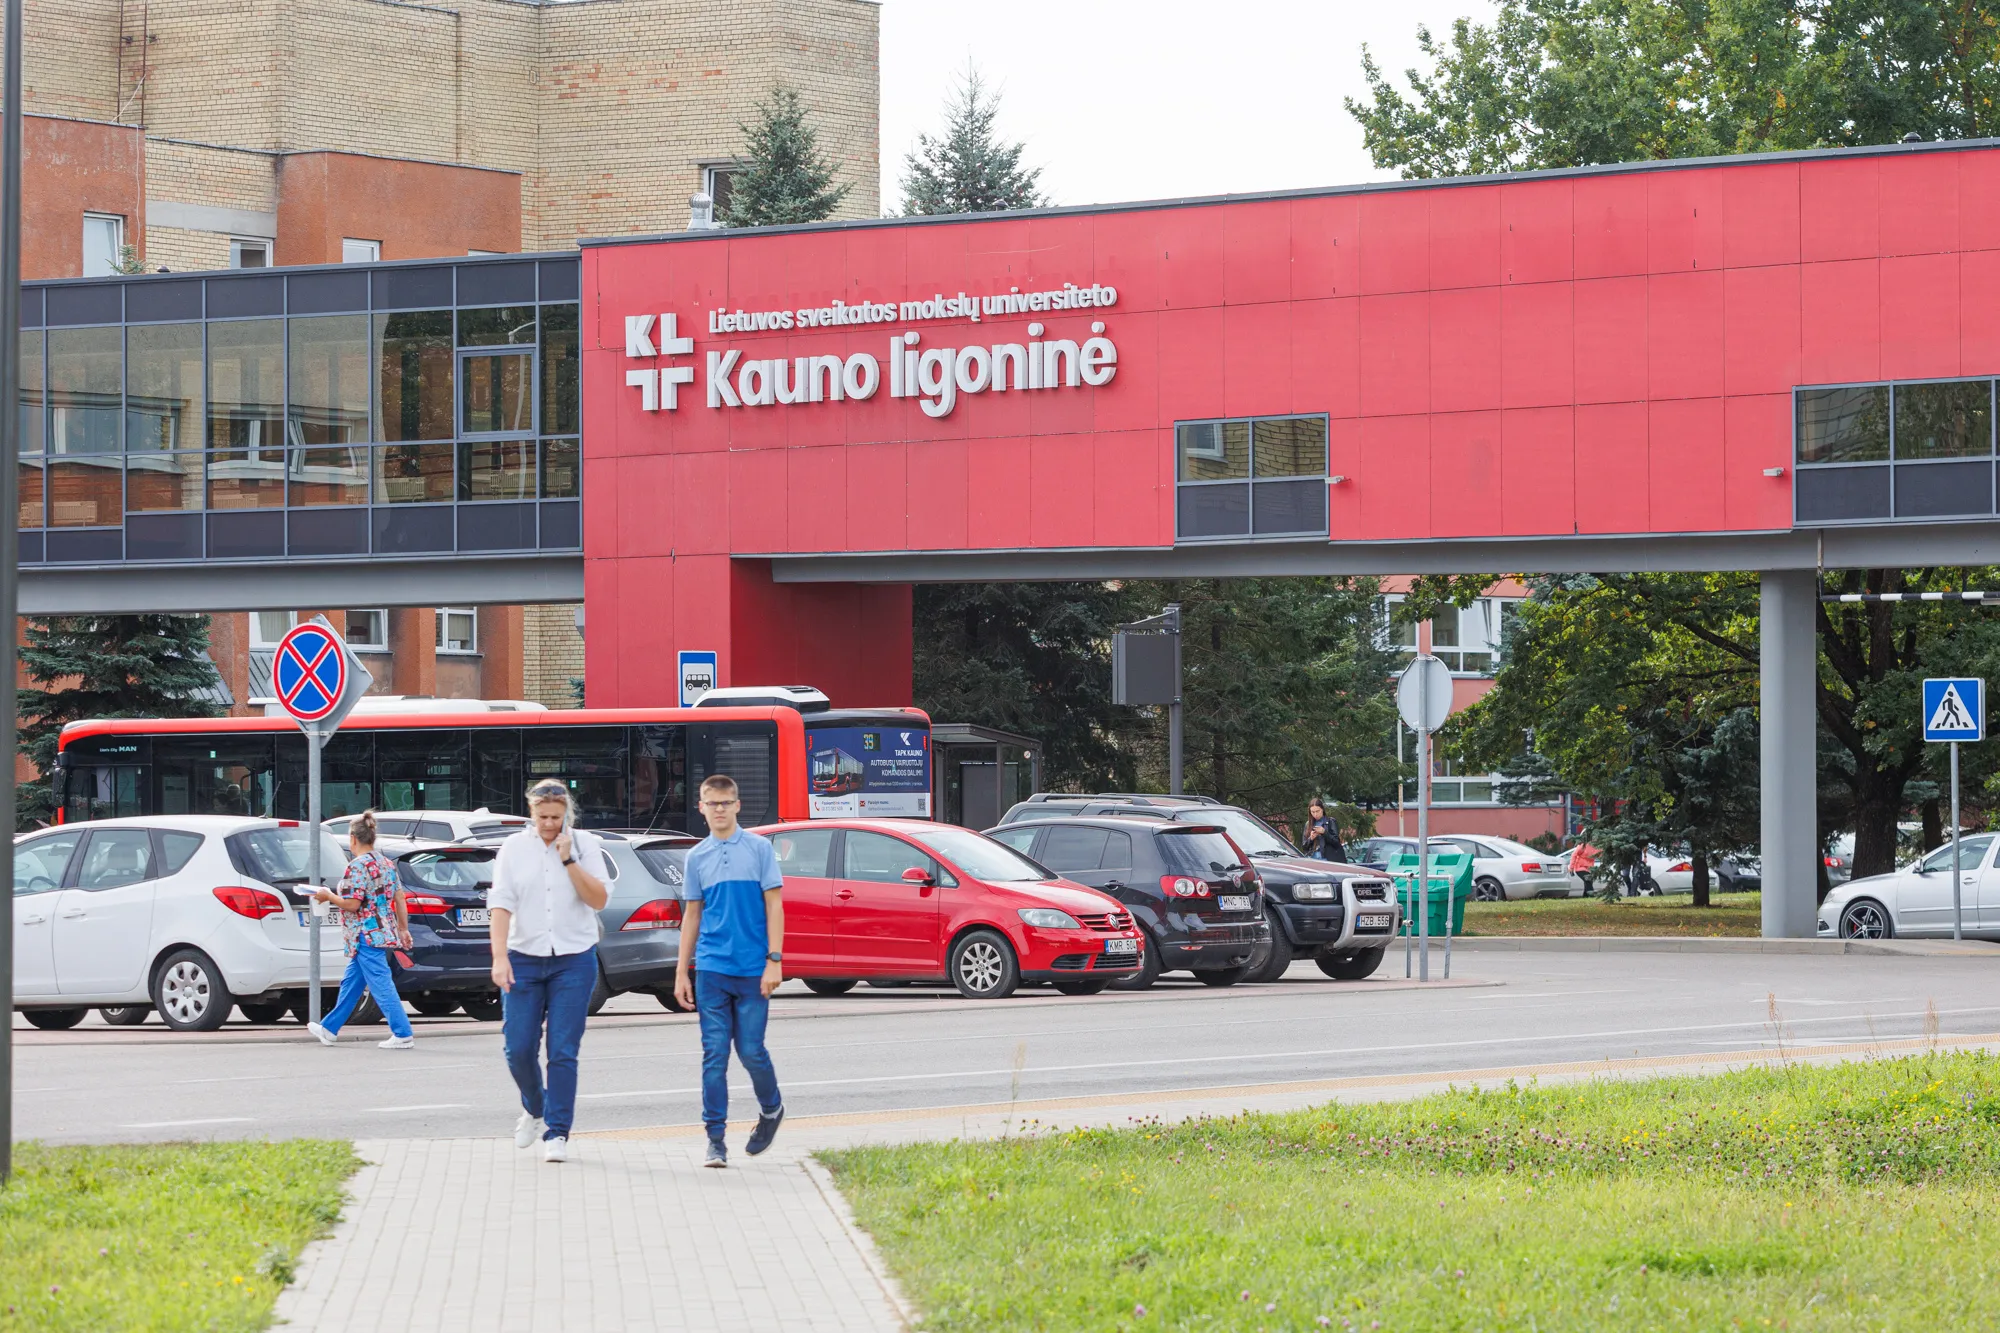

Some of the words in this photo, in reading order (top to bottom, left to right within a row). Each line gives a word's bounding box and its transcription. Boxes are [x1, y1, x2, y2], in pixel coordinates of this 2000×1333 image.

[709, 306, 794, 334] Lietuvos
[796, 299, 897, 328] sveikatos
[899, 291, 982, 323] mokslų
[982, 281, 1118, 316] universiteto
[706, 348, 880, 408] Kauno
[889, 320, 1118, 419] ligoninė
[1223, 896, 1237, 907] MNC
[461, 909, 482, 922] KZG
[1360, 916, 1374, 926] HZB
[1377, 916, 1390, 926] 556
[1109, 940, 1124, 952] KMR
